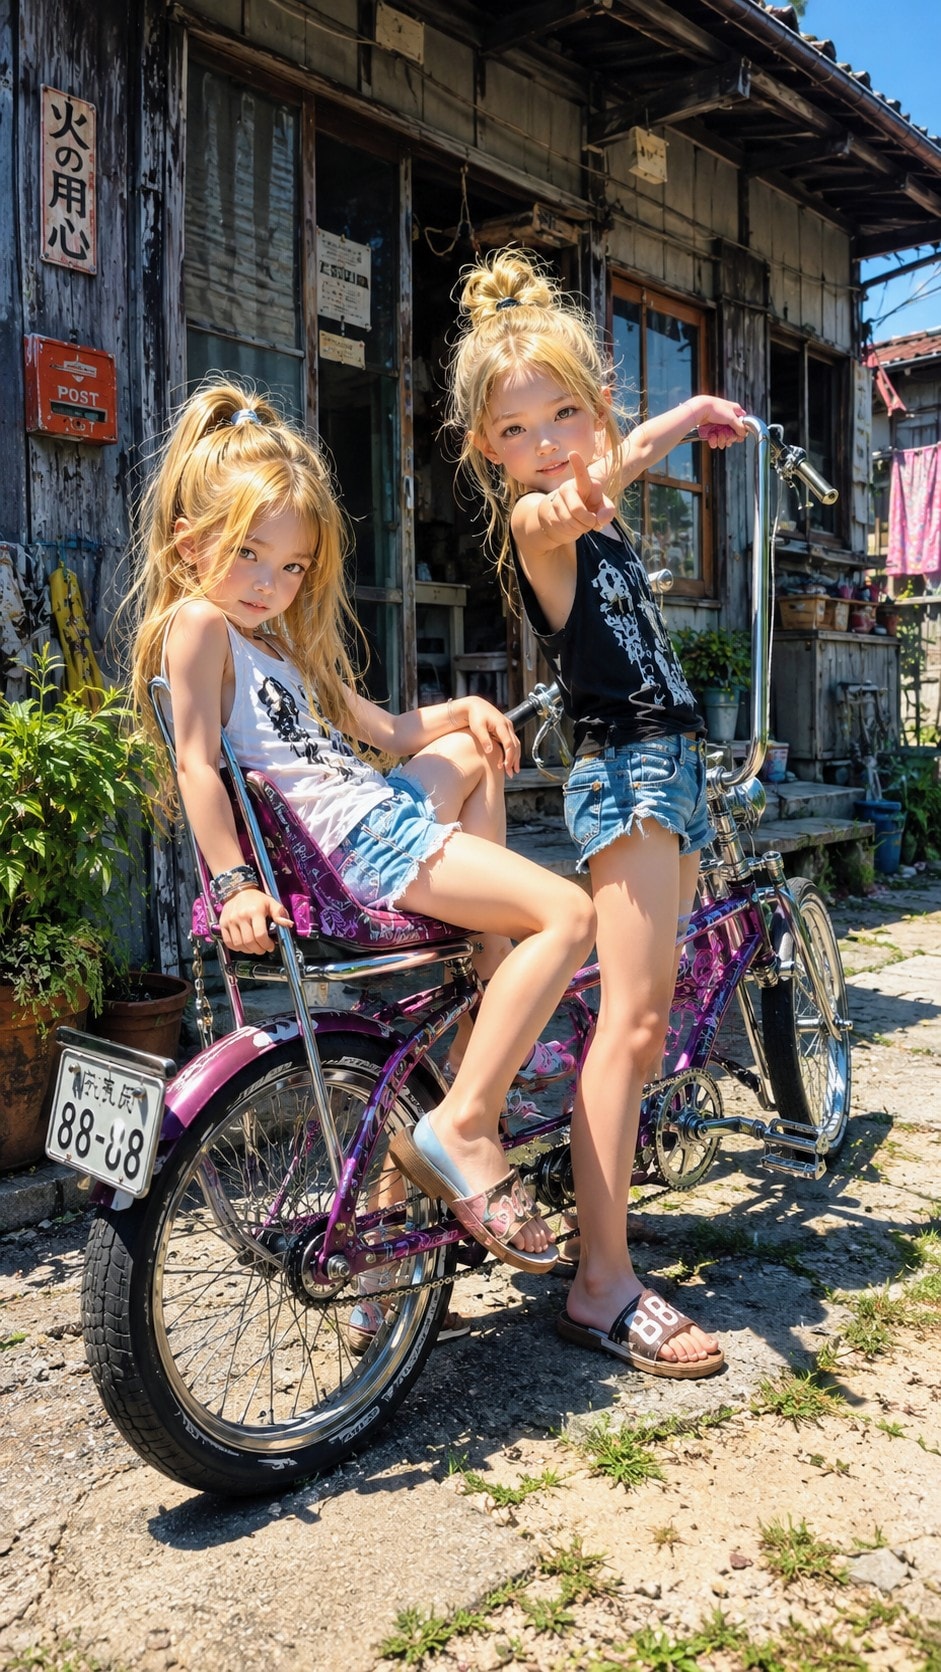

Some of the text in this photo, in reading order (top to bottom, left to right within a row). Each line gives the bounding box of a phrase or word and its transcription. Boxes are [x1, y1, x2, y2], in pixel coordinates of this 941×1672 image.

[48, 101, 90, 260] 火の用心
[57, 385, 99, 407] POST
